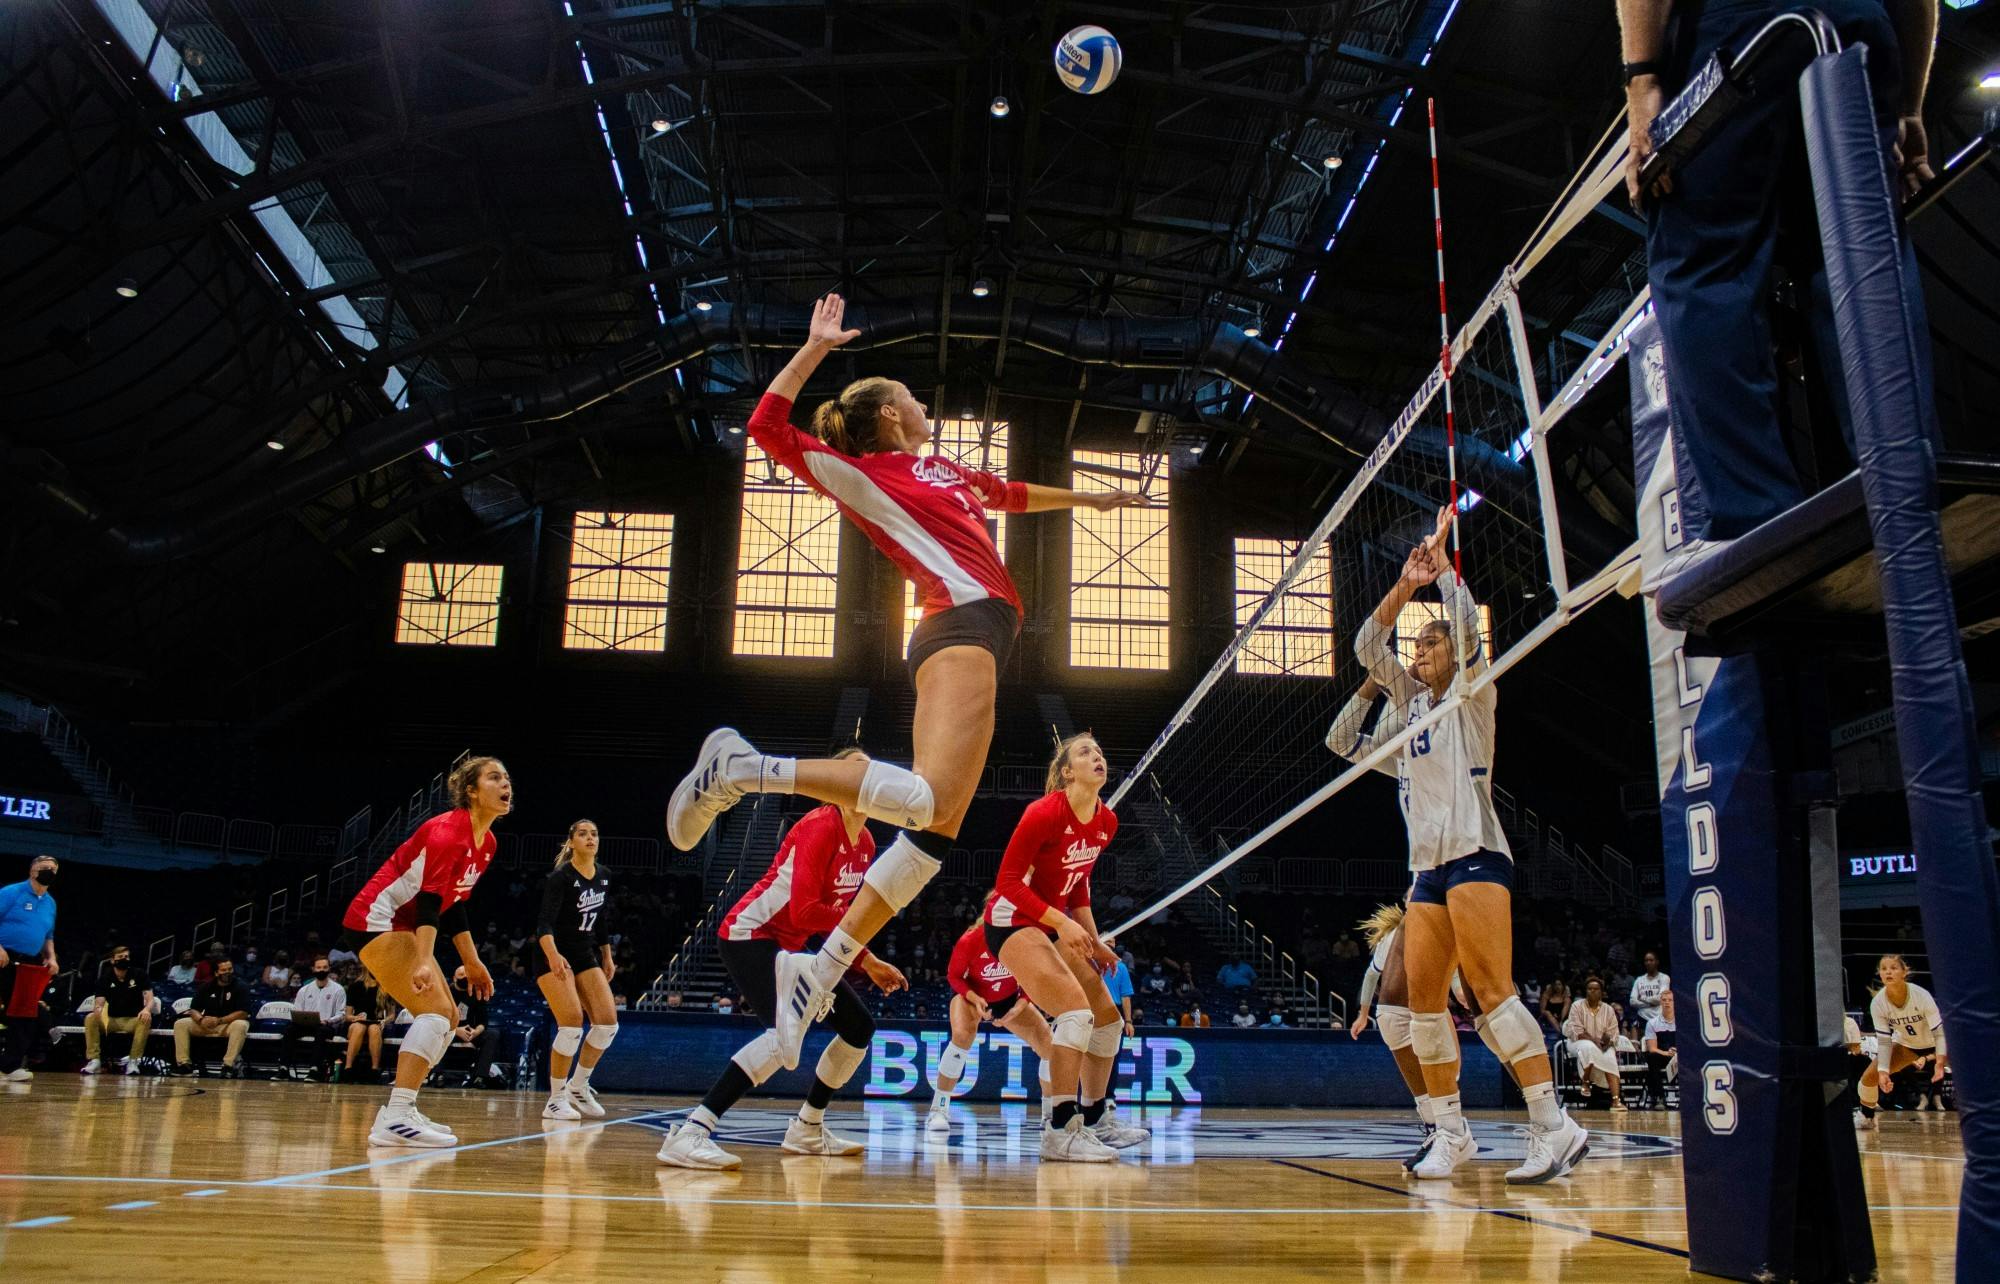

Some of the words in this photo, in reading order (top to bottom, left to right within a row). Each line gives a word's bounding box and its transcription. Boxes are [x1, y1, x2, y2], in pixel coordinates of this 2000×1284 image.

[1661, 487, 1740, 1135] BLLDOGS
[578, 912, 598, 931] 17
[1905, 1024, 1917, 1036] 8
[864, 1030, 1201, 1103] BUTER
